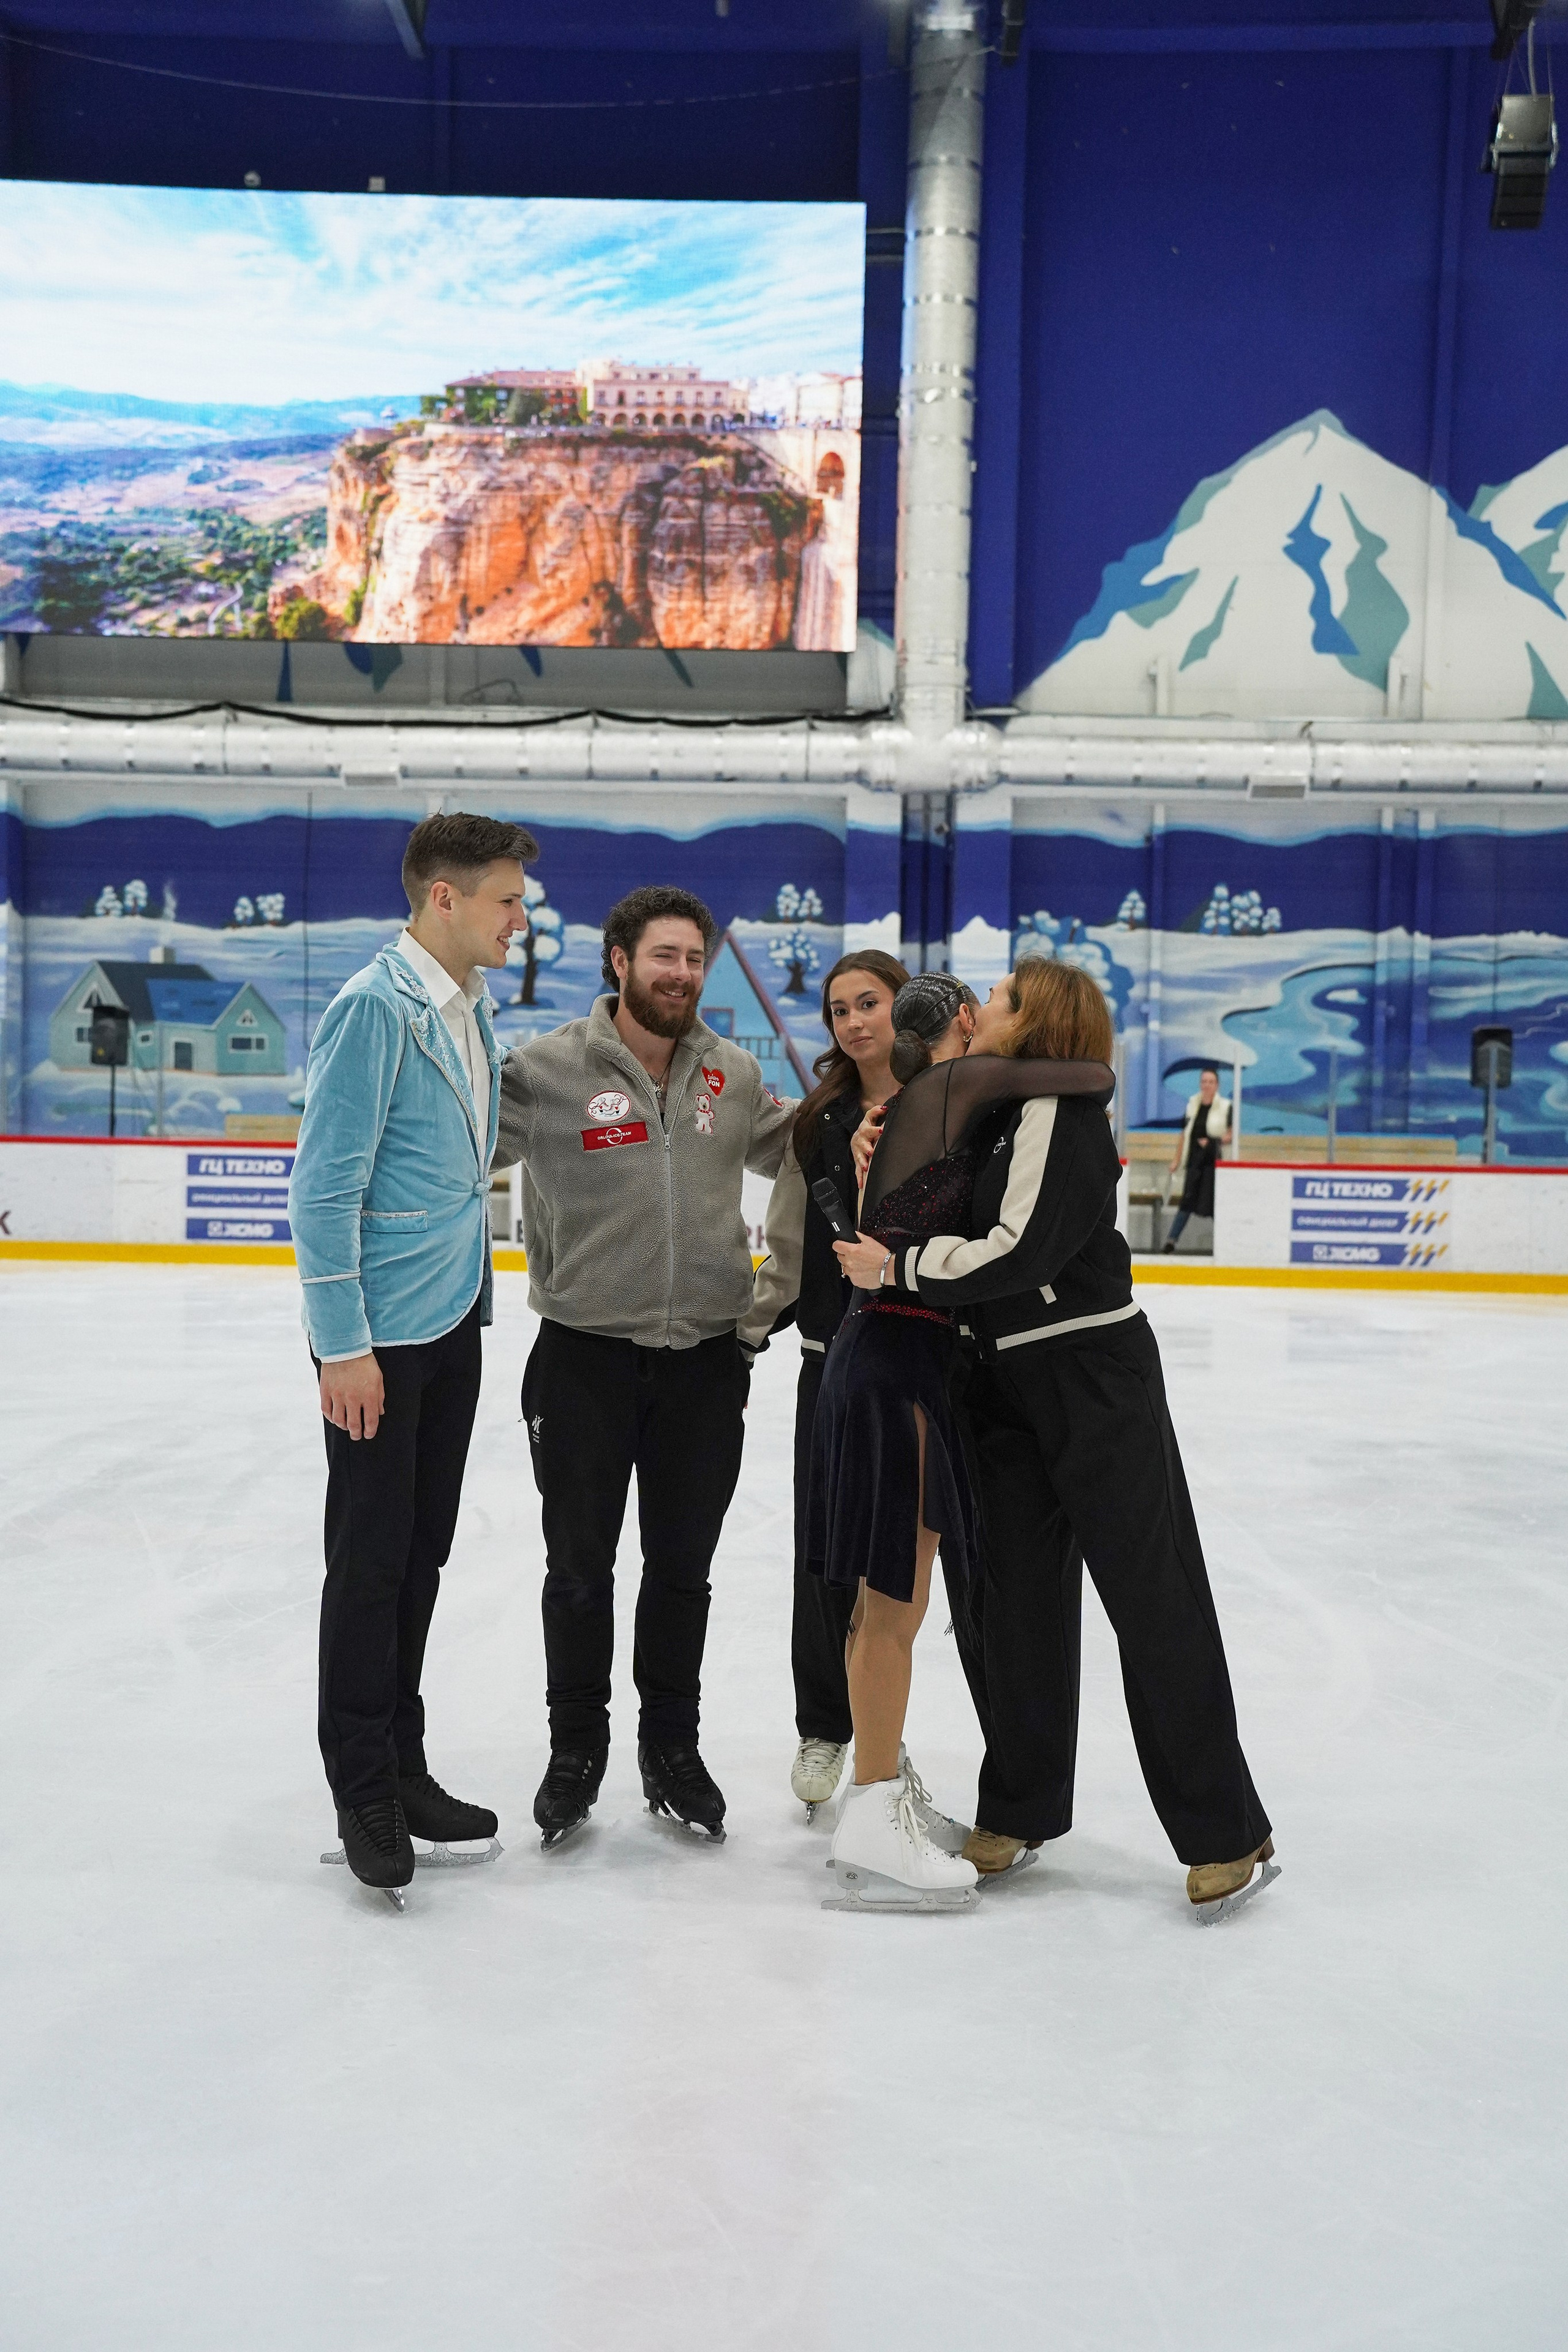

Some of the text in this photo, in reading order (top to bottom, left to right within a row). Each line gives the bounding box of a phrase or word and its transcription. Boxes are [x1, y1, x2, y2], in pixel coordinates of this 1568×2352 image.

[198, 1158, 286, 1175] ГЦ ТЕХНО
[1305, 1181, 1393, 1199] ГЦ ТЕХНО
